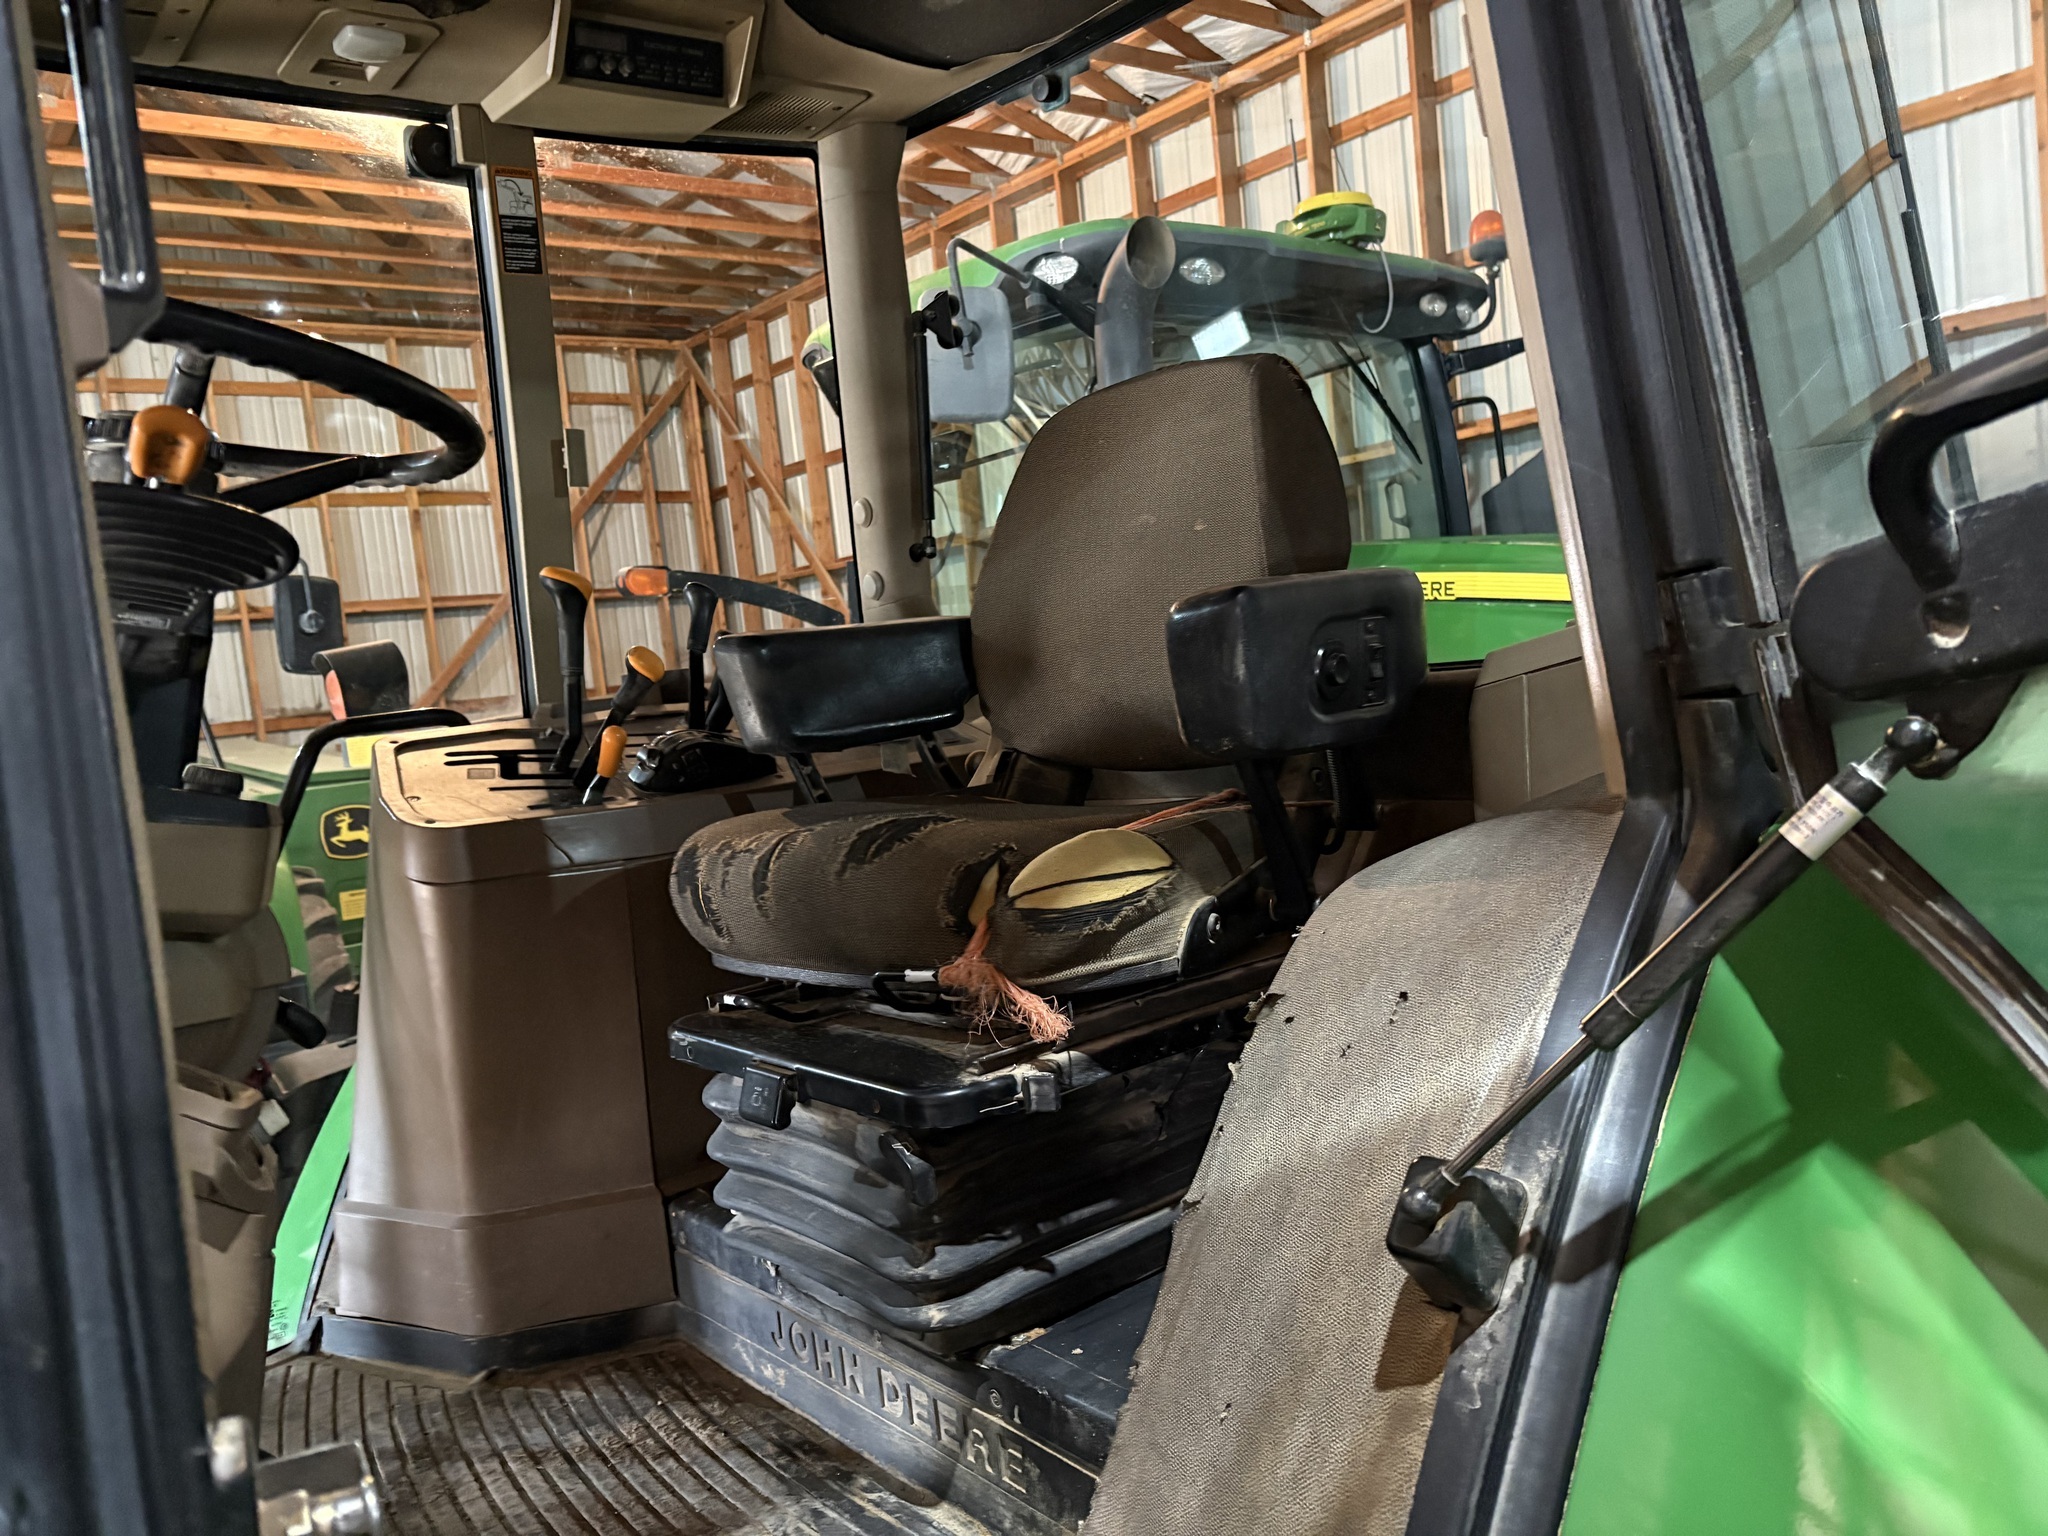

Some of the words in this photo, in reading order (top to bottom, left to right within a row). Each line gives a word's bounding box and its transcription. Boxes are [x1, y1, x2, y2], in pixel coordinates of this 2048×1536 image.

[499, 167, 533, 177] WARNING
[771, 1311, 865, 1398] JOHN
[877, 1367, 1028, 1494] DEERE
